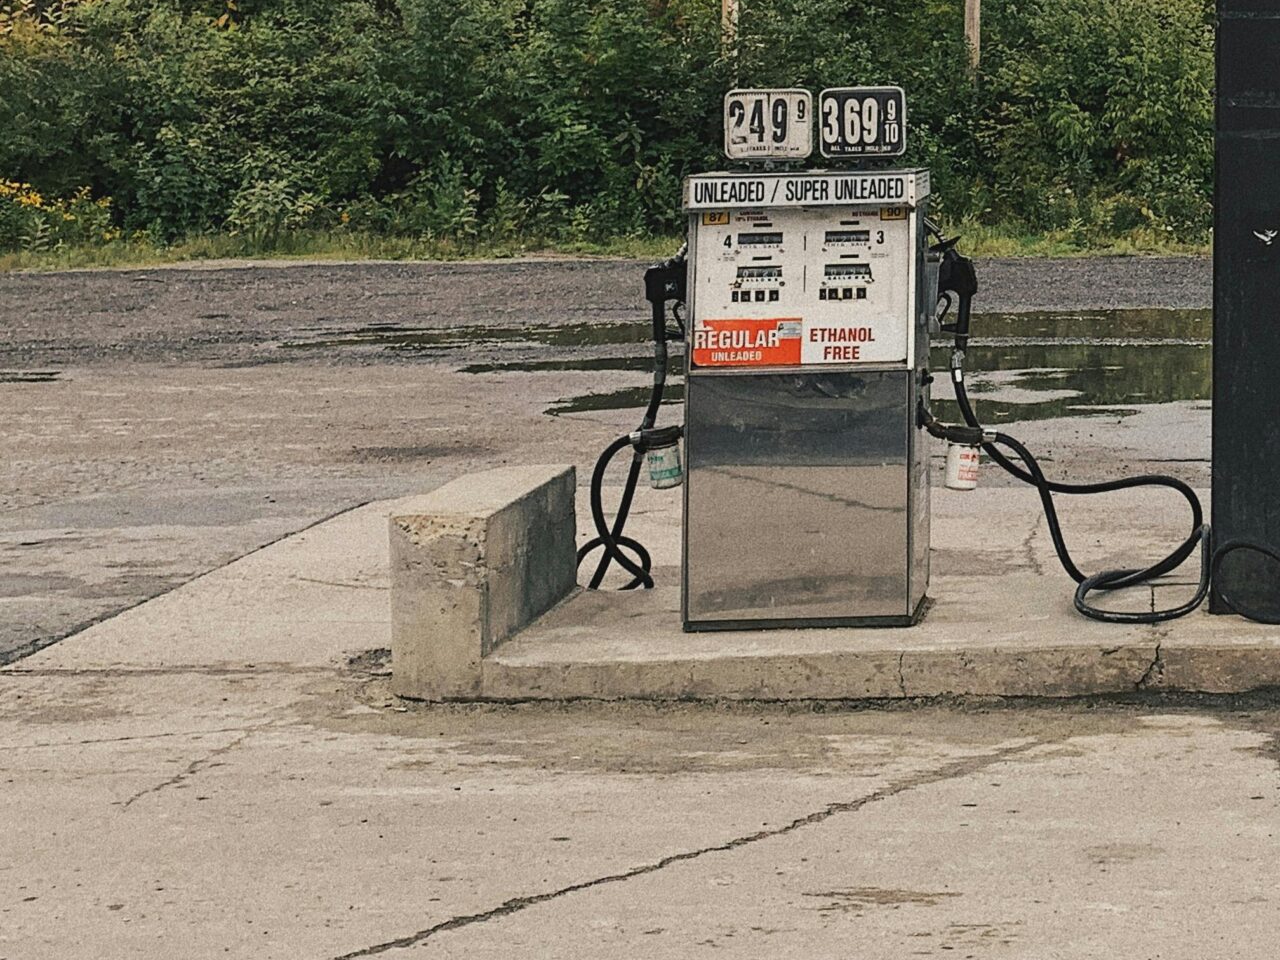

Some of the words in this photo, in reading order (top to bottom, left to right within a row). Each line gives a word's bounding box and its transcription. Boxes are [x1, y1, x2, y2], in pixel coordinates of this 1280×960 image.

[797, 100, 806, 120] 9
[695, 182, 764, 203] UNLEADED
[786, 178, 828, 201] SUPER
[835, 178, 904, 199] UNLEADED
[709, 212, 724, 222] 87
[887, 208, 901, 216] 90
[724, 234, 732, 248] 4
[876, 230, 884, 244] 3
[694, 330, 780, 349] REGULAR
[810, 328, 875, 342] ETHANOL
[711, 350, 762, 362] UNLEADED
[824, 346, 860, 360] FREE
